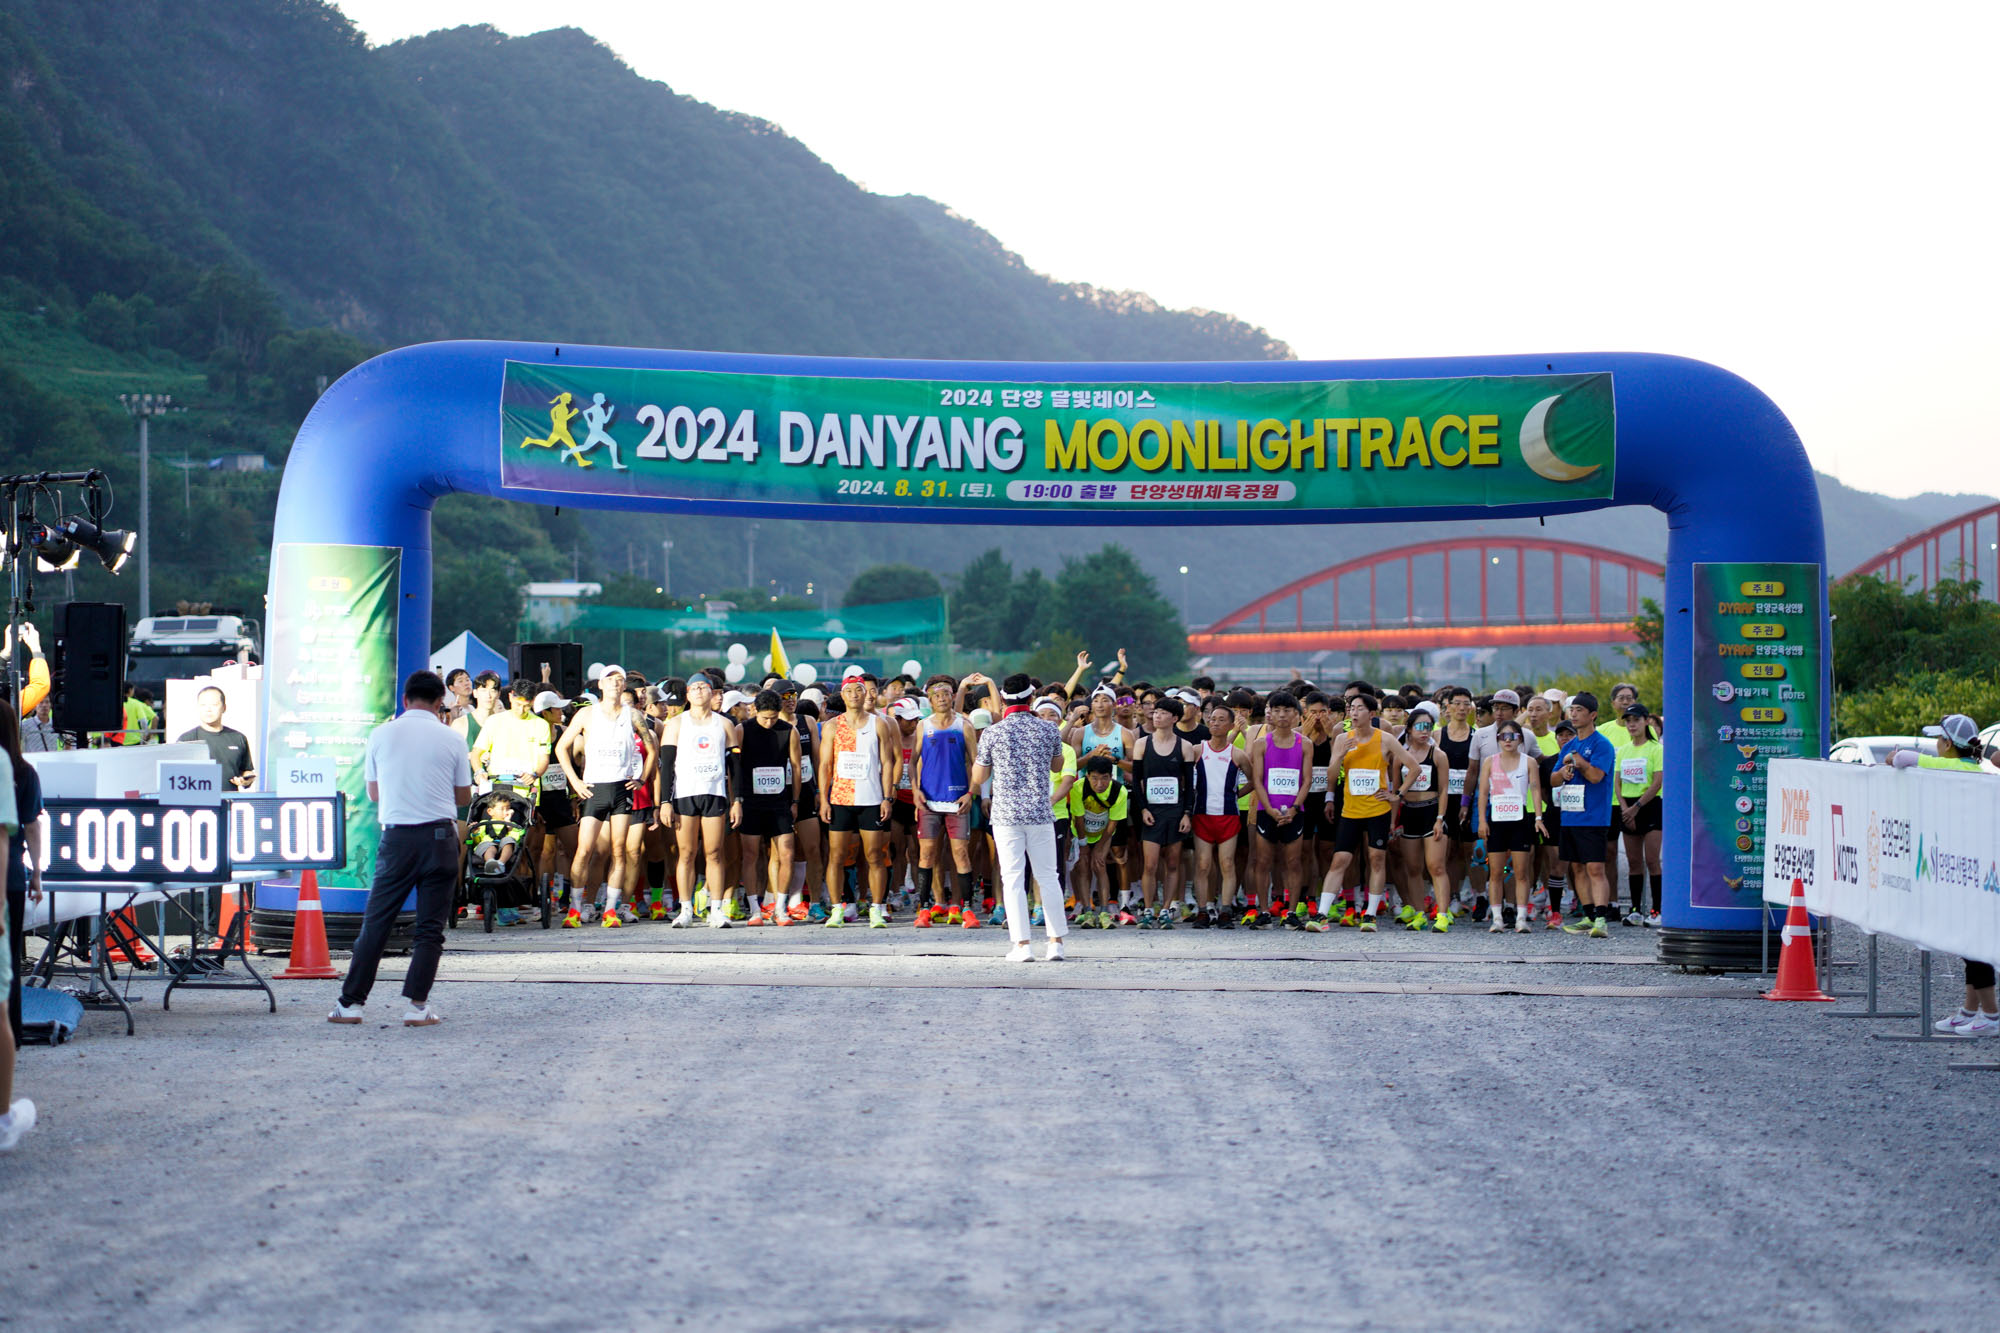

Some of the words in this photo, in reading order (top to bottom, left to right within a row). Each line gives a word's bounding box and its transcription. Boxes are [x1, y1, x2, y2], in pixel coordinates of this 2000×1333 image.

[940, 389, 993, 406] 2024
[1001, 389, 1043, 409] 단양
[1050, 390, 1157, 409] 달빛레이스
[635, 404, 759, 463] 2024
[780, 411, 1025, 471] DANYANG
[1045, 414, 1500, 472] MOONLIGHTRACE
[837, 479, 888, 496] 2024.
[894, 480, 911, 497] 8.
[920, 480, 953, 498] 31.
[1023, 484, 1073, 499] 19:00
[1080, 484, 1117, 500] 출발
[1130, 484, 1280, 500] 단양생태체육공원
[168, 776, 212, 791] 13km
[290, 769, 323, 784] 5km
[757, 778, 780, 786] 10190
[1272, 778, 1296, 786] 10076
[1352, 778, 1374, 786] 10197
[1150, 786, 1174, 795] 10005
[1495, 804, 1520, 812] 16009
